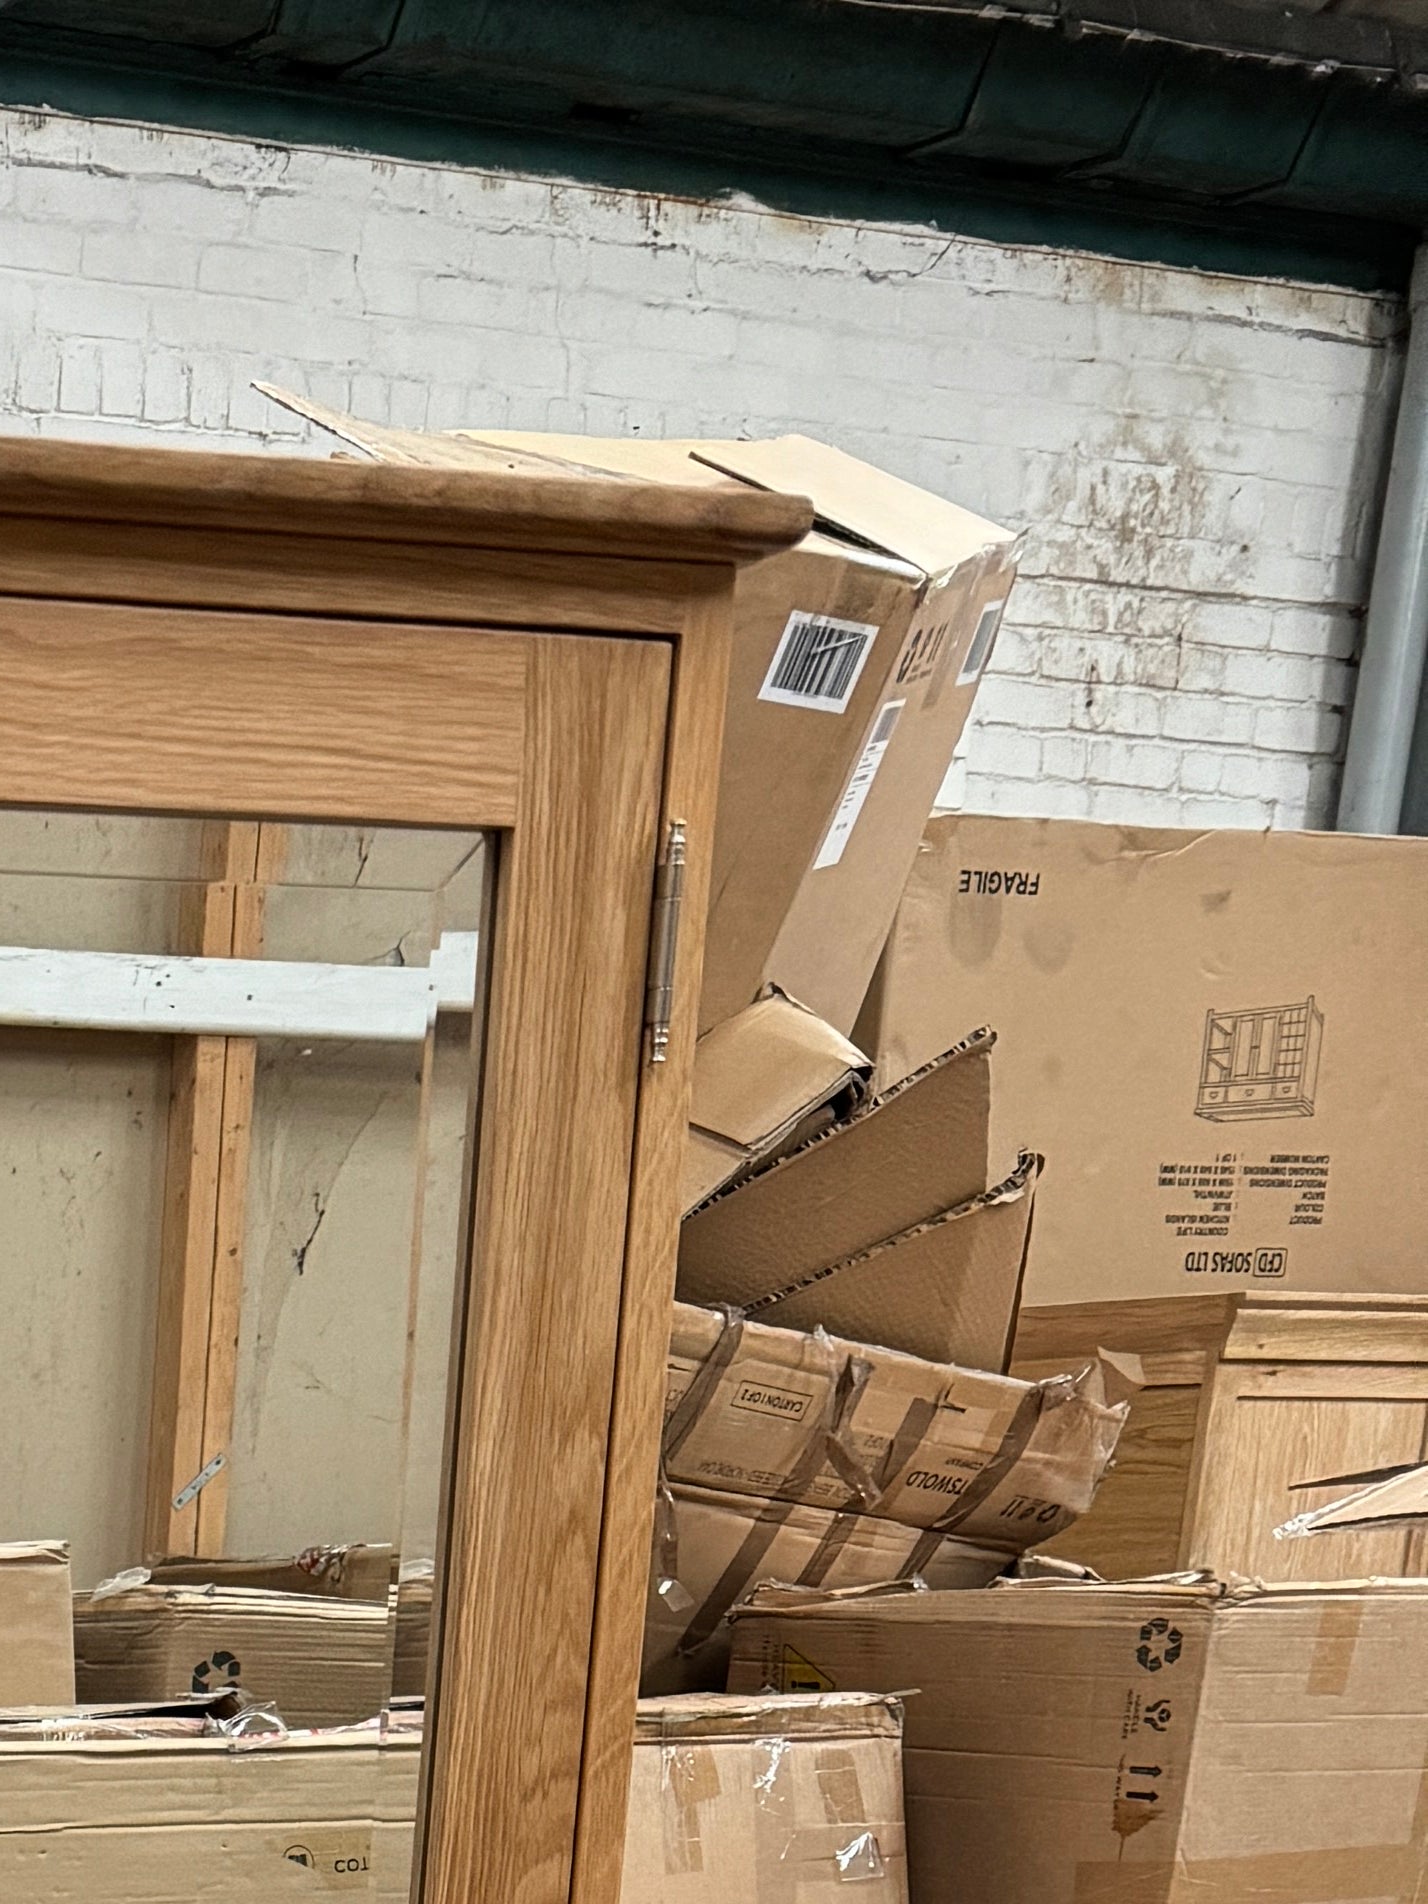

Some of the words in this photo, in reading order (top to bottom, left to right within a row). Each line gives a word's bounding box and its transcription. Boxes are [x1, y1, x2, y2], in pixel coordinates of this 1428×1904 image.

[958, 866, 1040, 899] FRAGILE
[1185, 1252, 1208, 1272] LTD
[1211, 1252, 1253, 1272] SOFAS
[1257, 1252, 1283, 1272] CFD
[764, 1394, 803, 1413] CARTON
